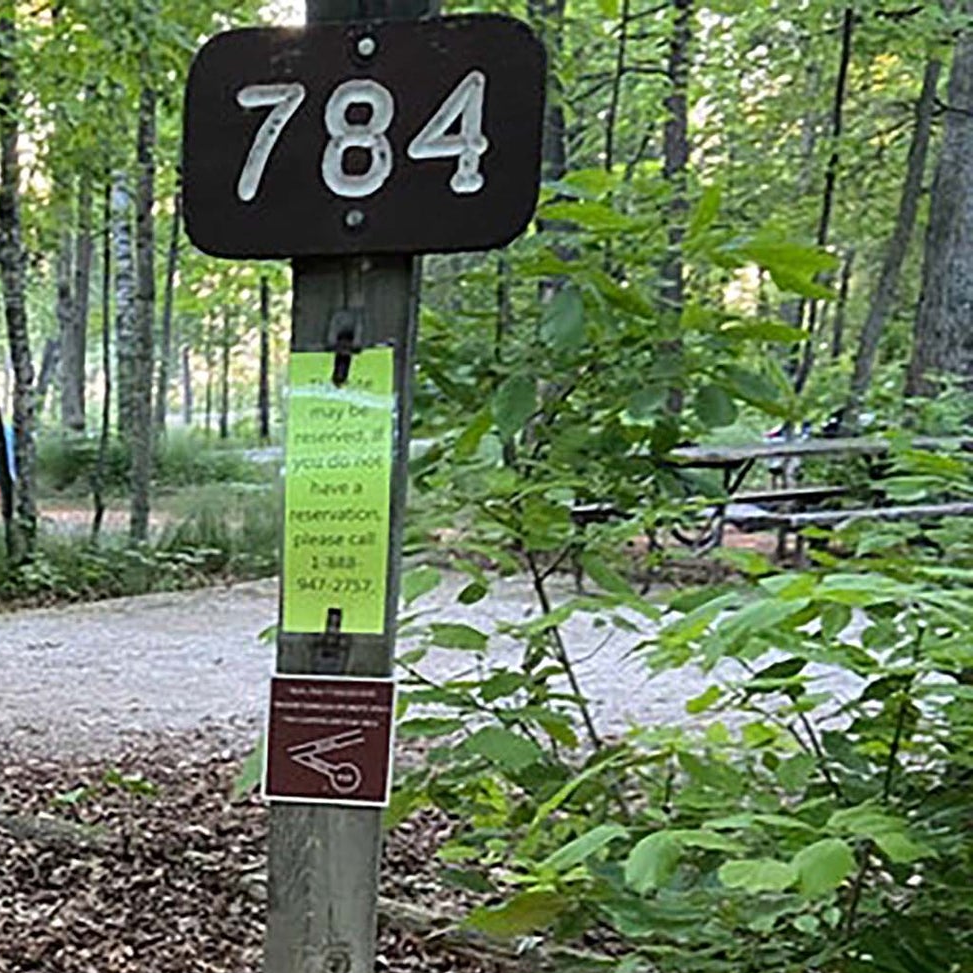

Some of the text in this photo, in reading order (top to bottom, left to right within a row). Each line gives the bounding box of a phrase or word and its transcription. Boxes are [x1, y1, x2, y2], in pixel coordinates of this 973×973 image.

[237, 70, 489, 201] 784
[310, 407, 344, 422] may
[292, 457, 324, 474] you
[310, 480, 348, 495] have
[294, 531, 376, 548] please call
